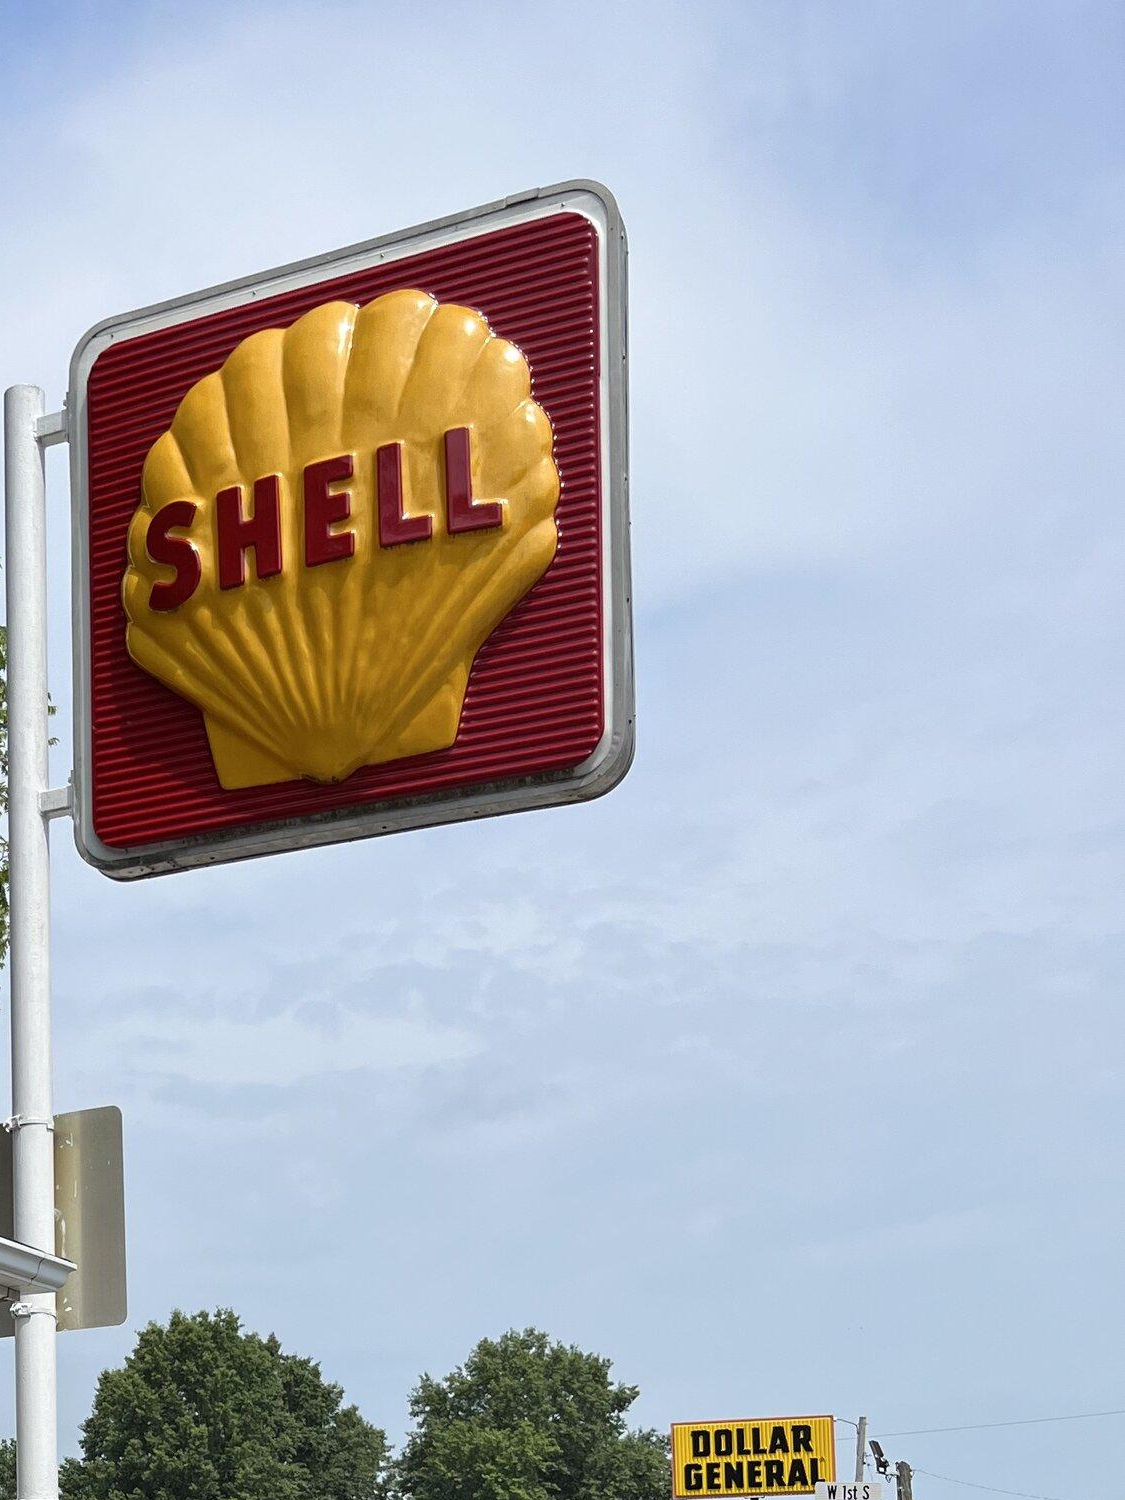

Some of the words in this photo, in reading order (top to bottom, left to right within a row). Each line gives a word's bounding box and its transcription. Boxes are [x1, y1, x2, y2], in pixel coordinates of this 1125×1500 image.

[145, 427, 504, 613] SHELL
[691, 1424, 814, 1458] DOLLAR
[684, 1457, 826, 1491] GENERAL
[827, 1485, 837, 1500] W
[843, 1485, 858, 1500] 1st
